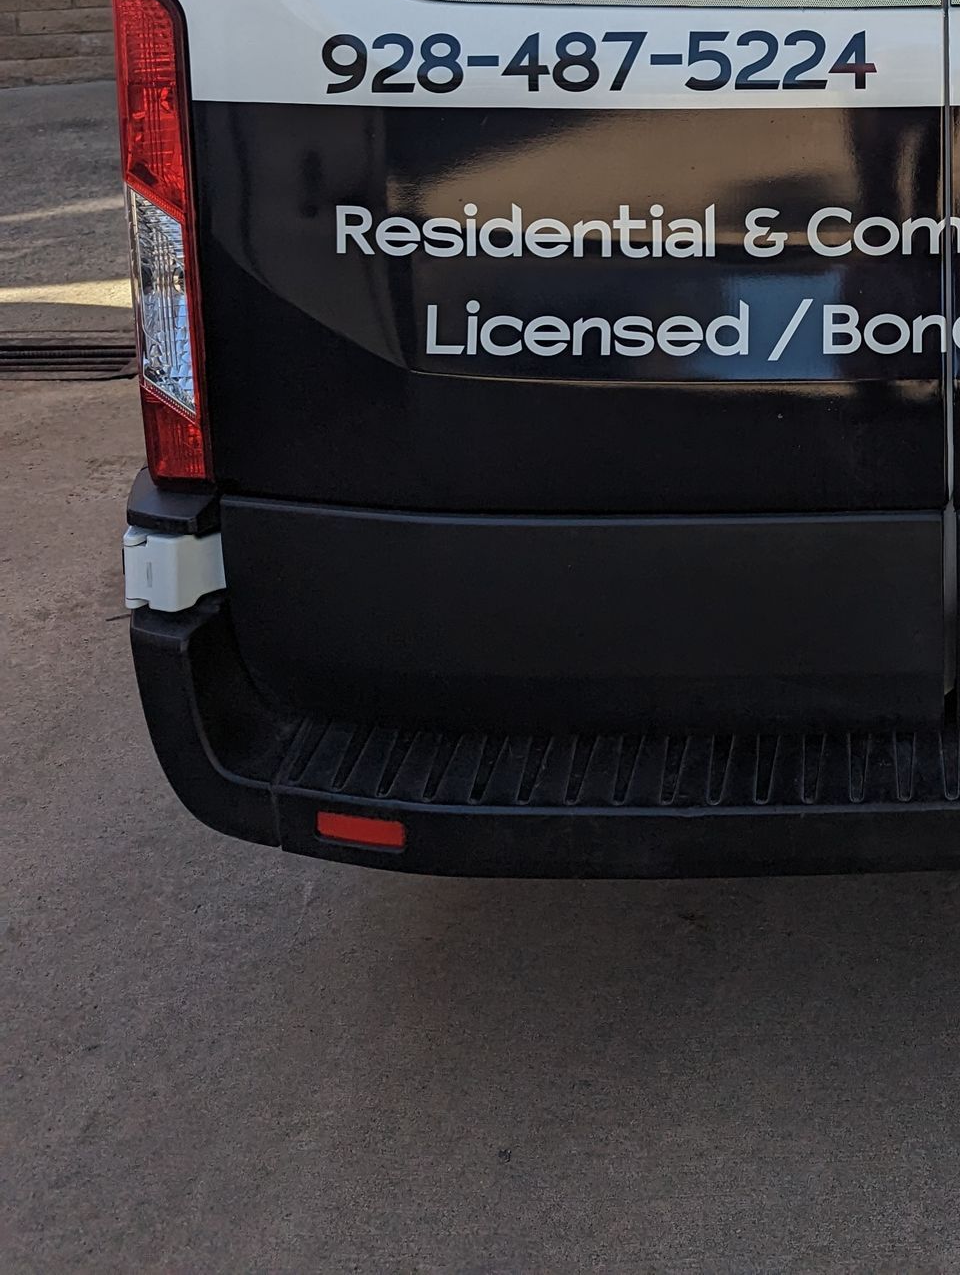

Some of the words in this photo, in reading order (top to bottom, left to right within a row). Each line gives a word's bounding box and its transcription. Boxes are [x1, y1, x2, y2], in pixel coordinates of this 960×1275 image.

[321, 29, 878, 94] 928-487-5224
[335, 203, 716, 258] Residential
[743, 208, 788, 257] &
[425, 300, 750, 357] Licensed
